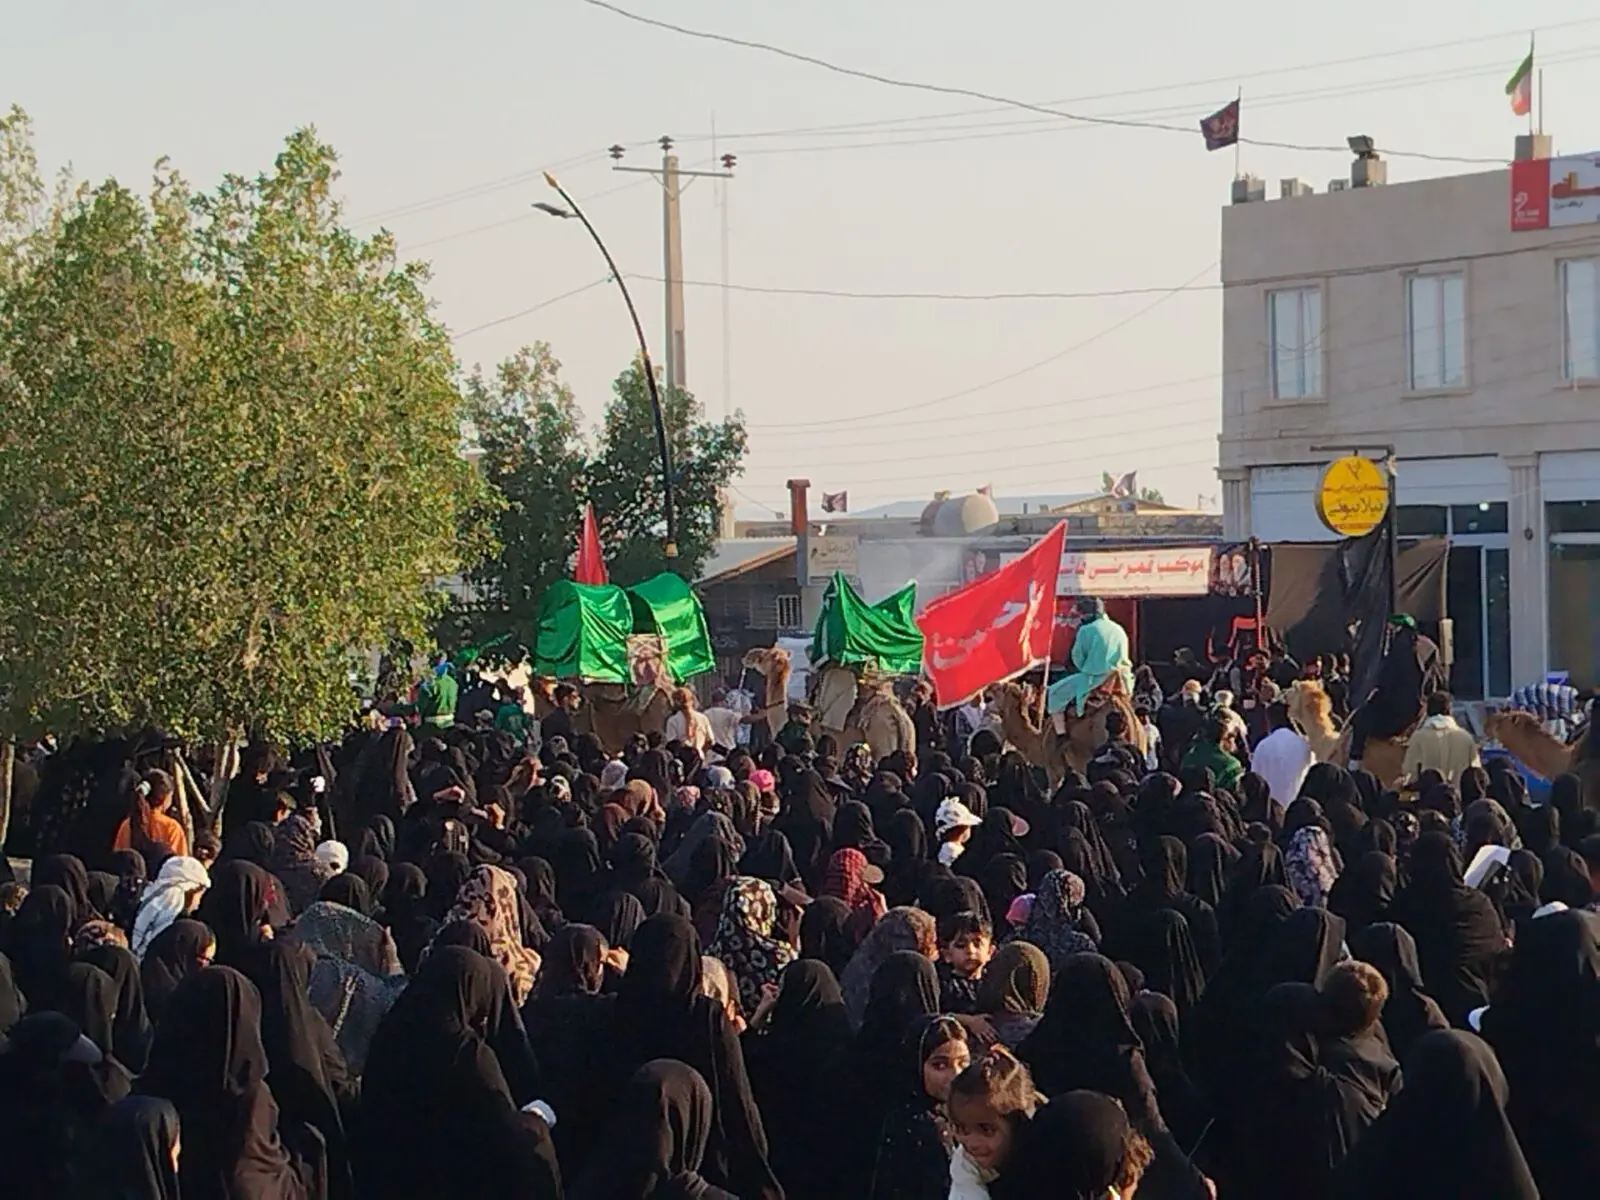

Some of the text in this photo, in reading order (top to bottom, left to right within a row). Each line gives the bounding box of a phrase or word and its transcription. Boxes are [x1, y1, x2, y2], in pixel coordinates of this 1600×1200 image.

[1059, 554, 1204, 580] موکب قمر بنی هاش
